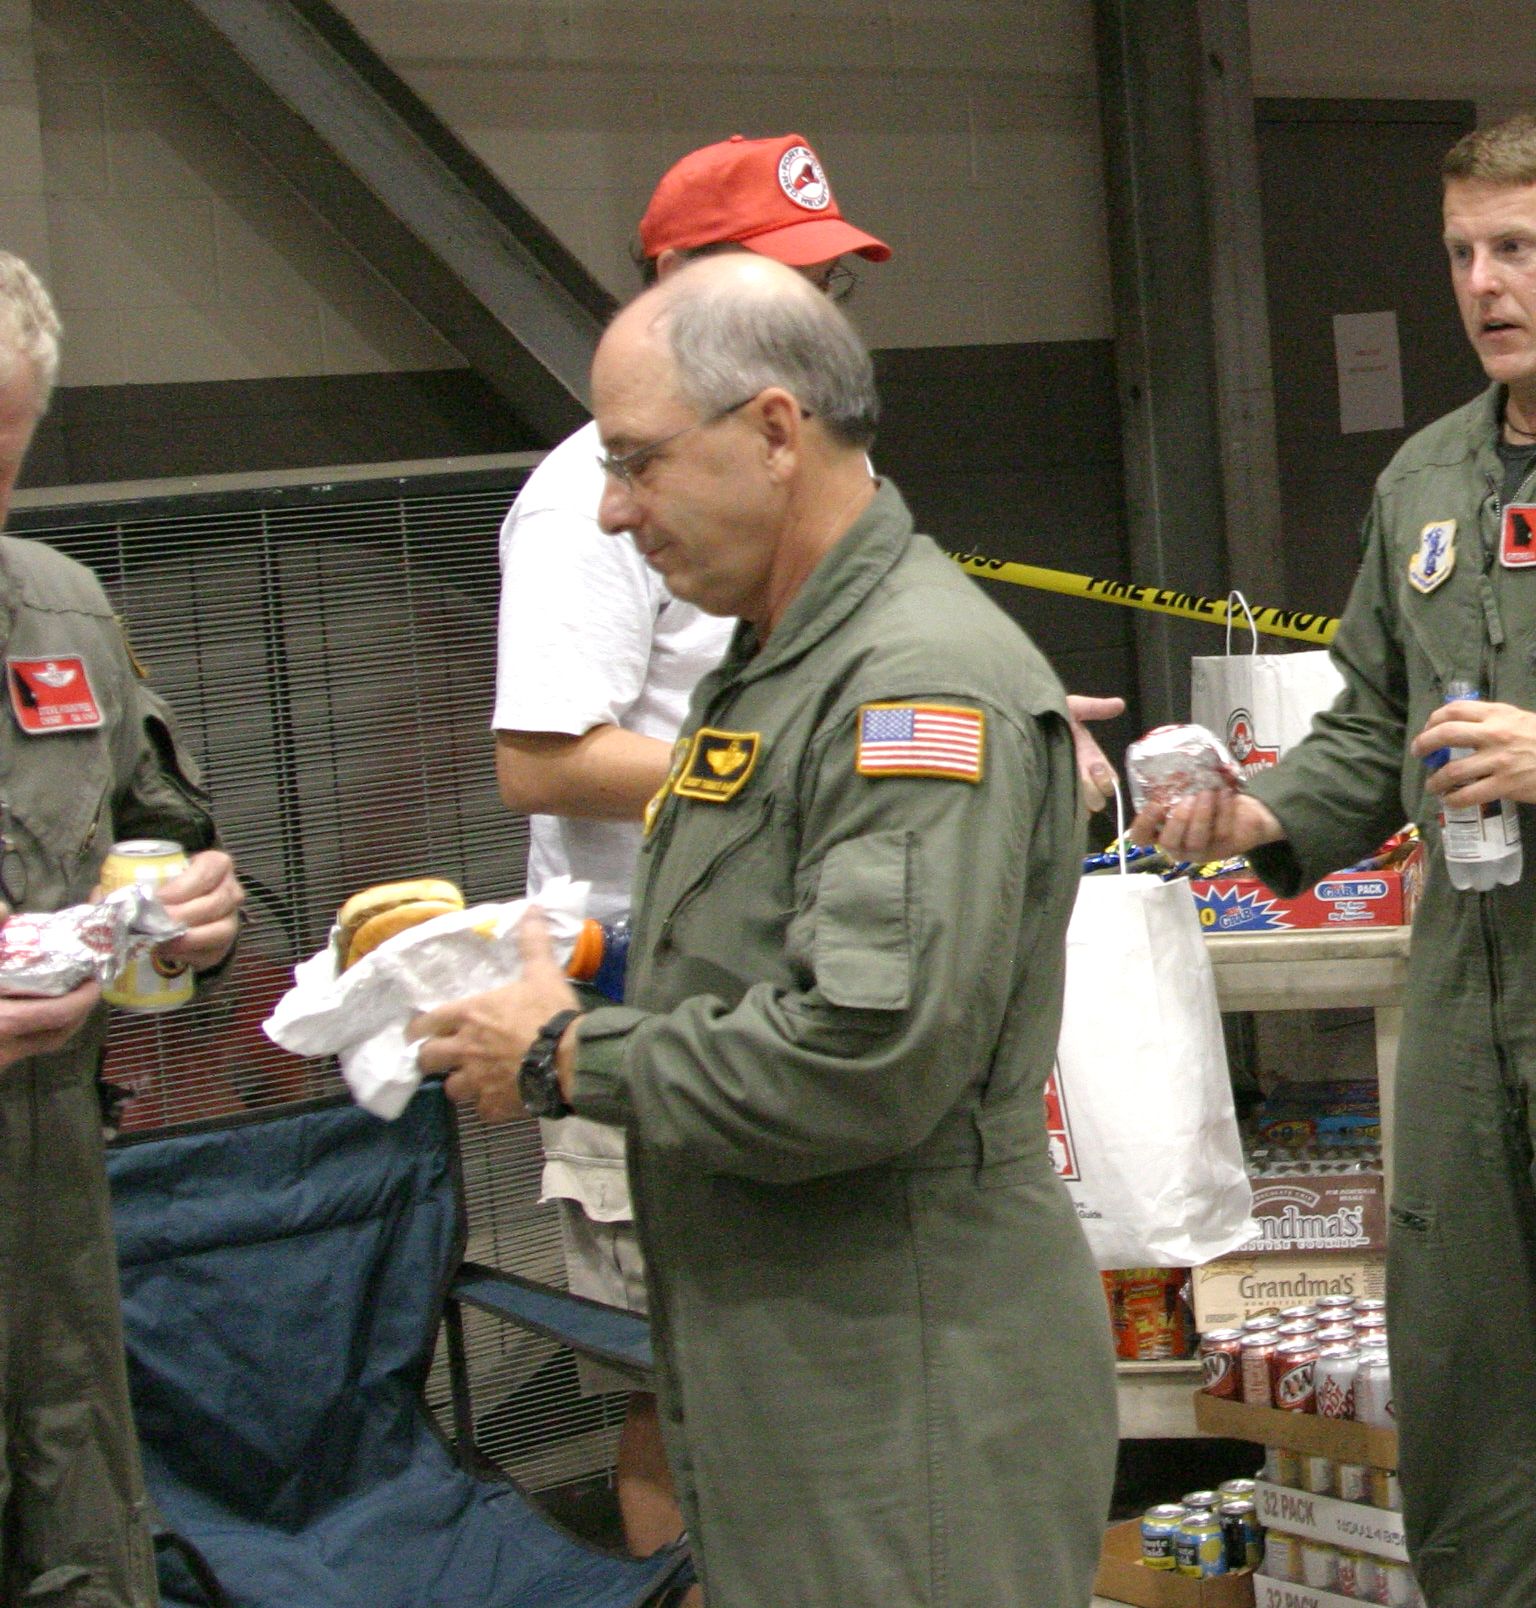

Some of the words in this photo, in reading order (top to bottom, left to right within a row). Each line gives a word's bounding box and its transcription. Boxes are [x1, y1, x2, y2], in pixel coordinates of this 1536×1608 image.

[1357, 884, 1382, 895] PACK
[1259, 1207, 1361, 1239] ndma's
[1239, 1272, 1356, 1299] Grandma's
[1263, 1489, 1278, 1516] 32
[1281, 1494, 1317, 1527] PACK
